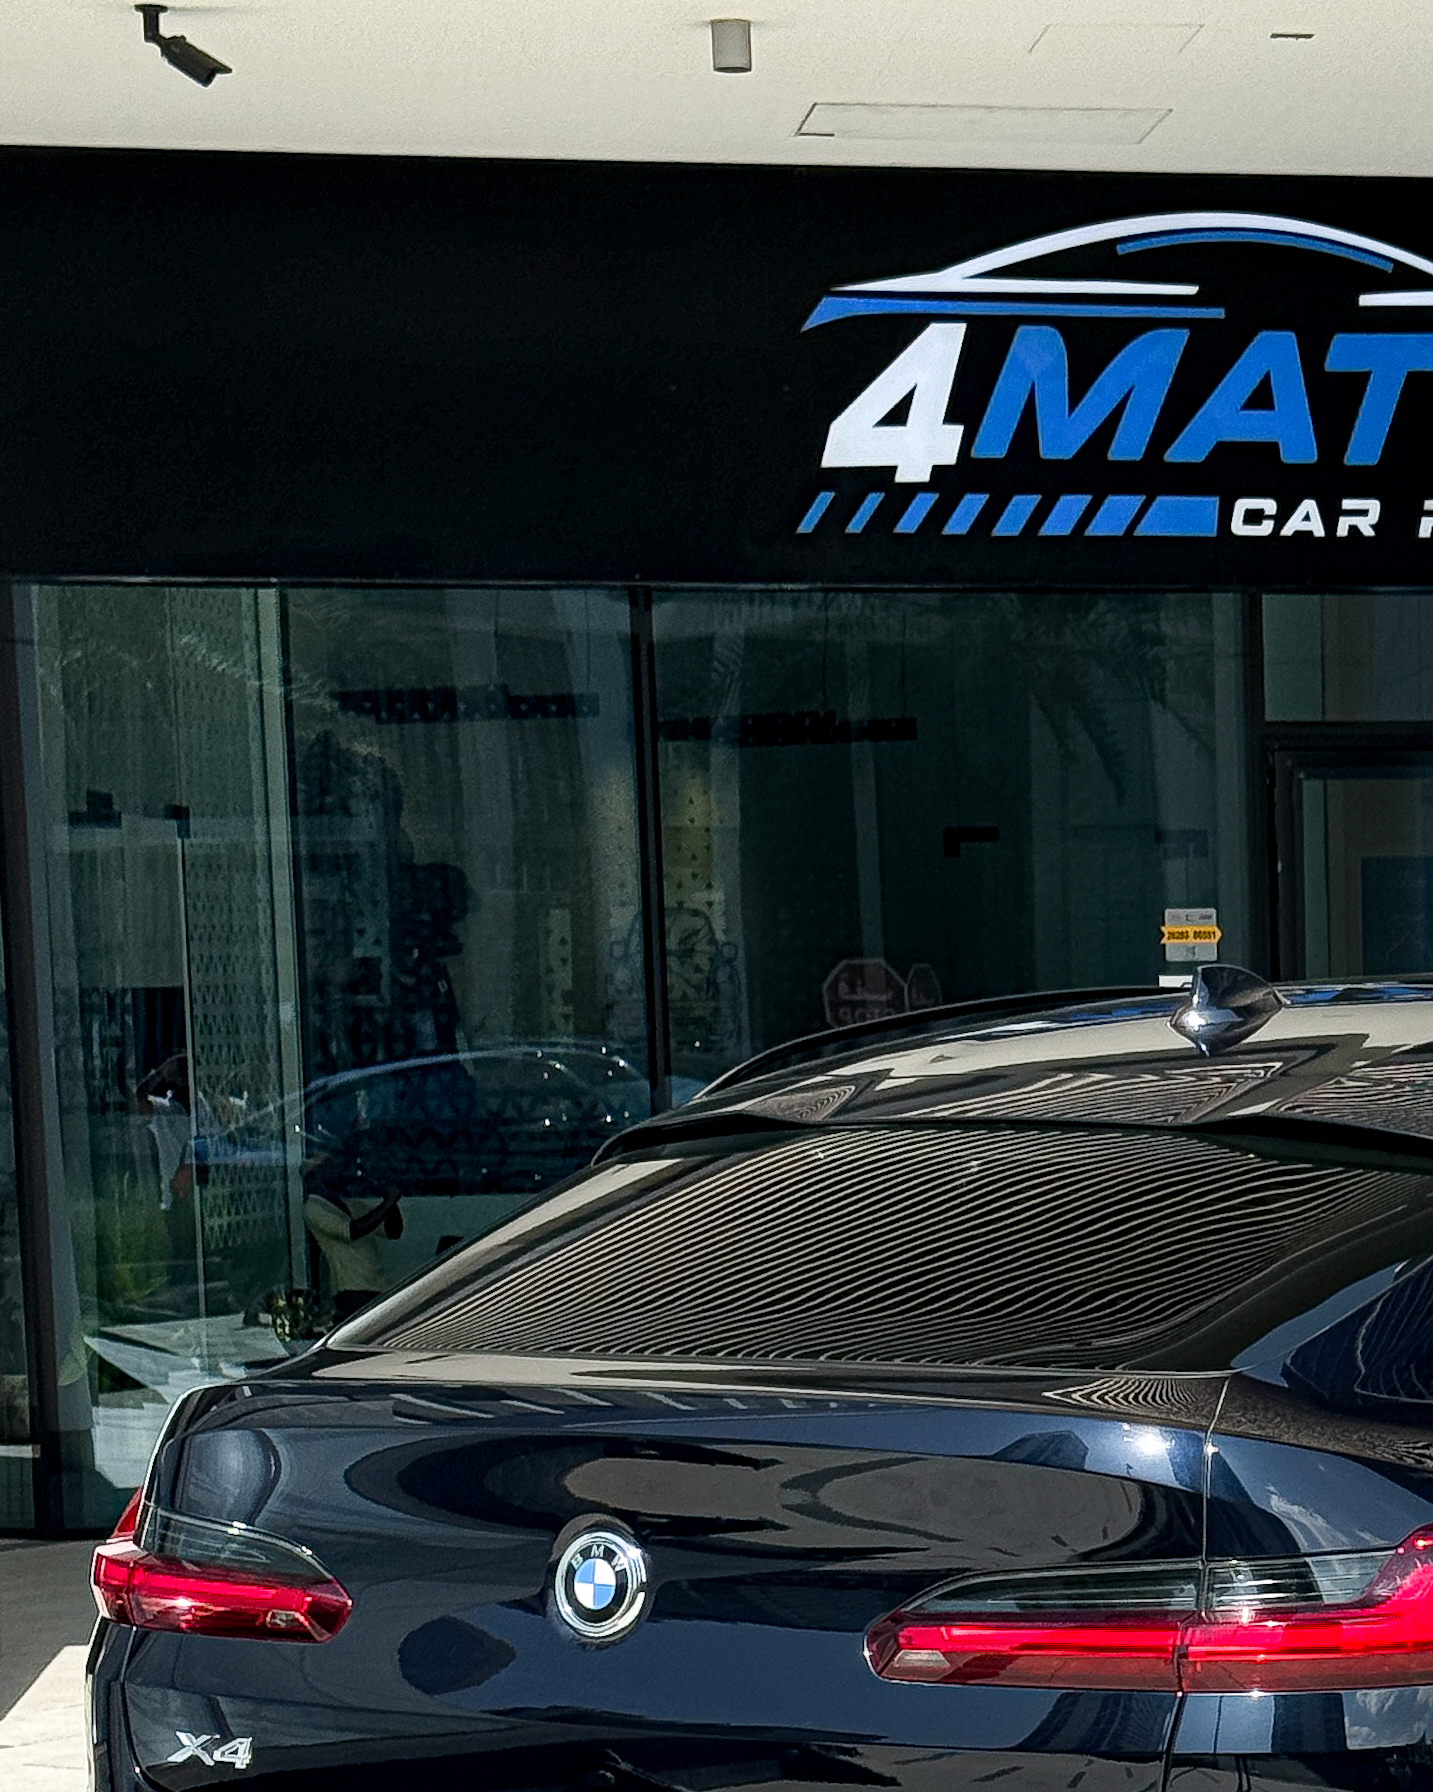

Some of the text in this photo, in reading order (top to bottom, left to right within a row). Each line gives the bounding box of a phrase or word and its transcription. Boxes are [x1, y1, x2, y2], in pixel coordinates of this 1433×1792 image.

[1231, 497, 1382, 540] CAR
[571, 1544, 628, 1572] BMW
[166, 1730, 253, 1770] X4
